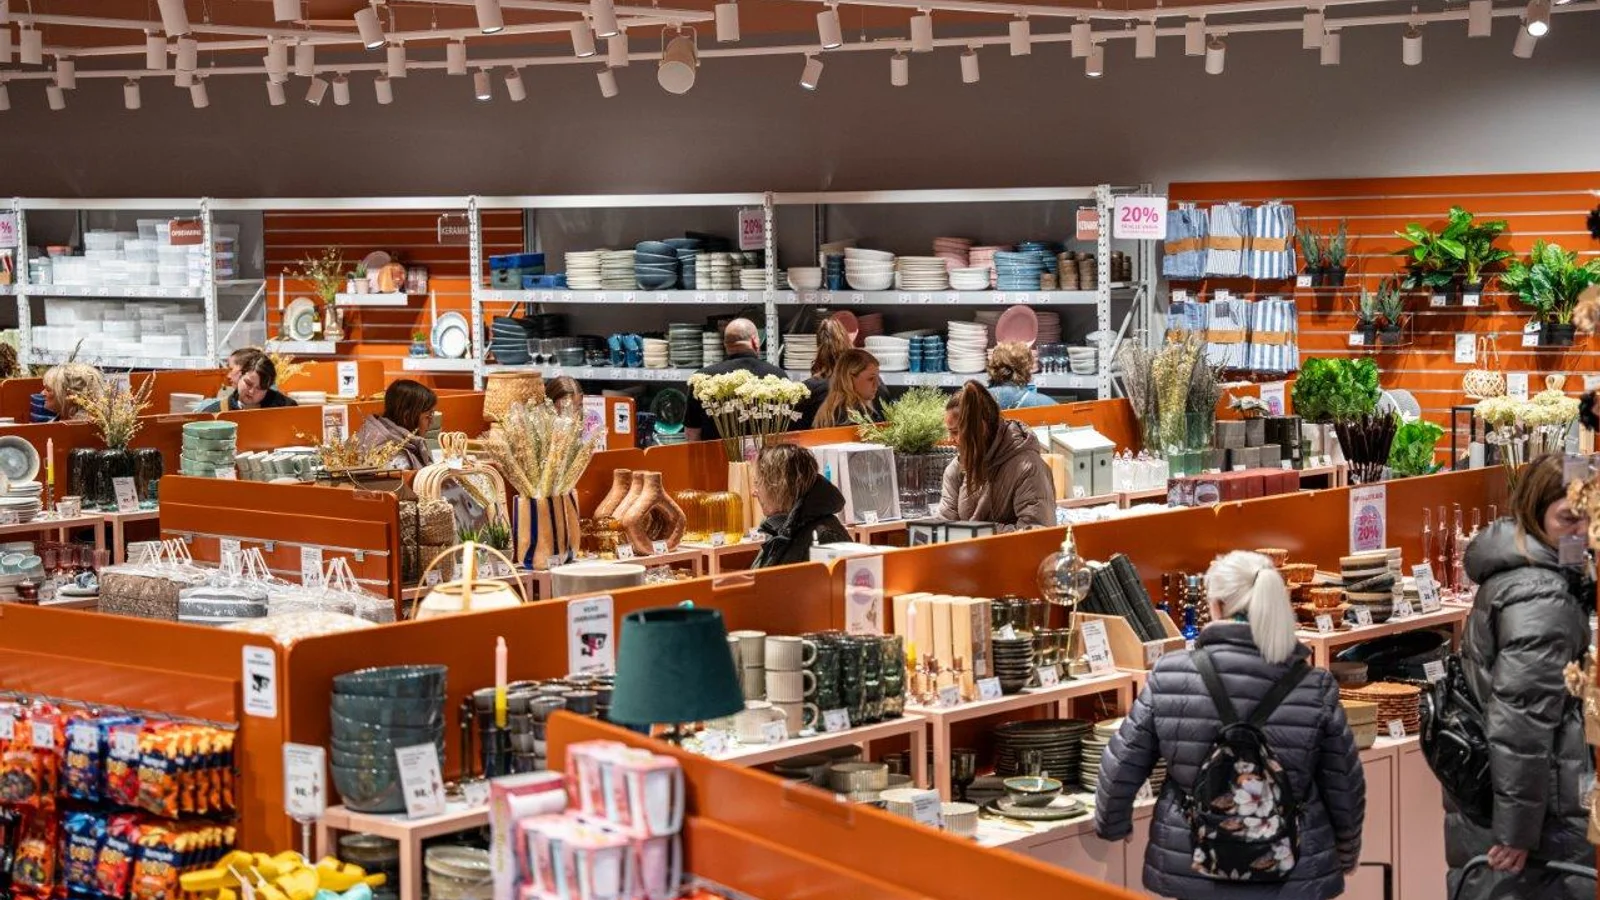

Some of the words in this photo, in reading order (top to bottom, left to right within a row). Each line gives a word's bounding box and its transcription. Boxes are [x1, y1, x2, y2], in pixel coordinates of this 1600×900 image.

[1121, 206, 1159, 223] 20%
[743, 219, 763, 235] 20%
[1357, 525, 1379, 541] 20%
